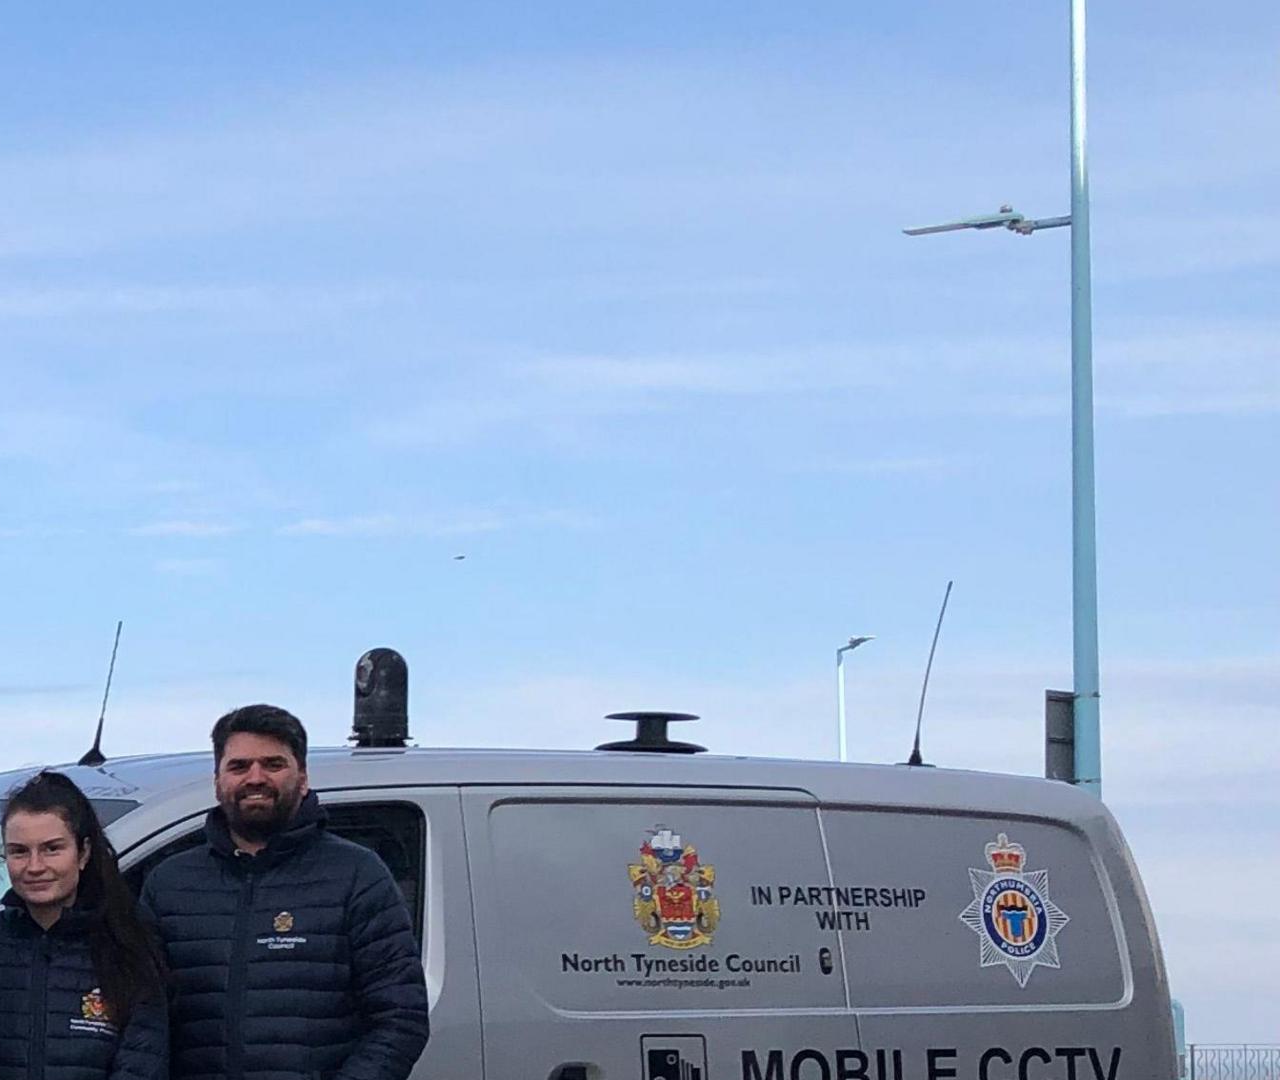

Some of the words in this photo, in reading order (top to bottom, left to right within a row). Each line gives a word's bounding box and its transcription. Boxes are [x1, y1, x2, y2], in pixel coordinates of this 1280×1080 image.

[751, 886, 772, 906] IN
[778, 886, 926, 908] PARTNERSHIP
[984, 879, 1043, 915] NORTHUMBRIA
[815, 910, 871, 931] WITH
[1000, 942, 1037, 956] POLICE
[561, 953, 625, 973] North
[631, 954, 720, 977] Tyneside
[725, 953, 801, 973] Council
